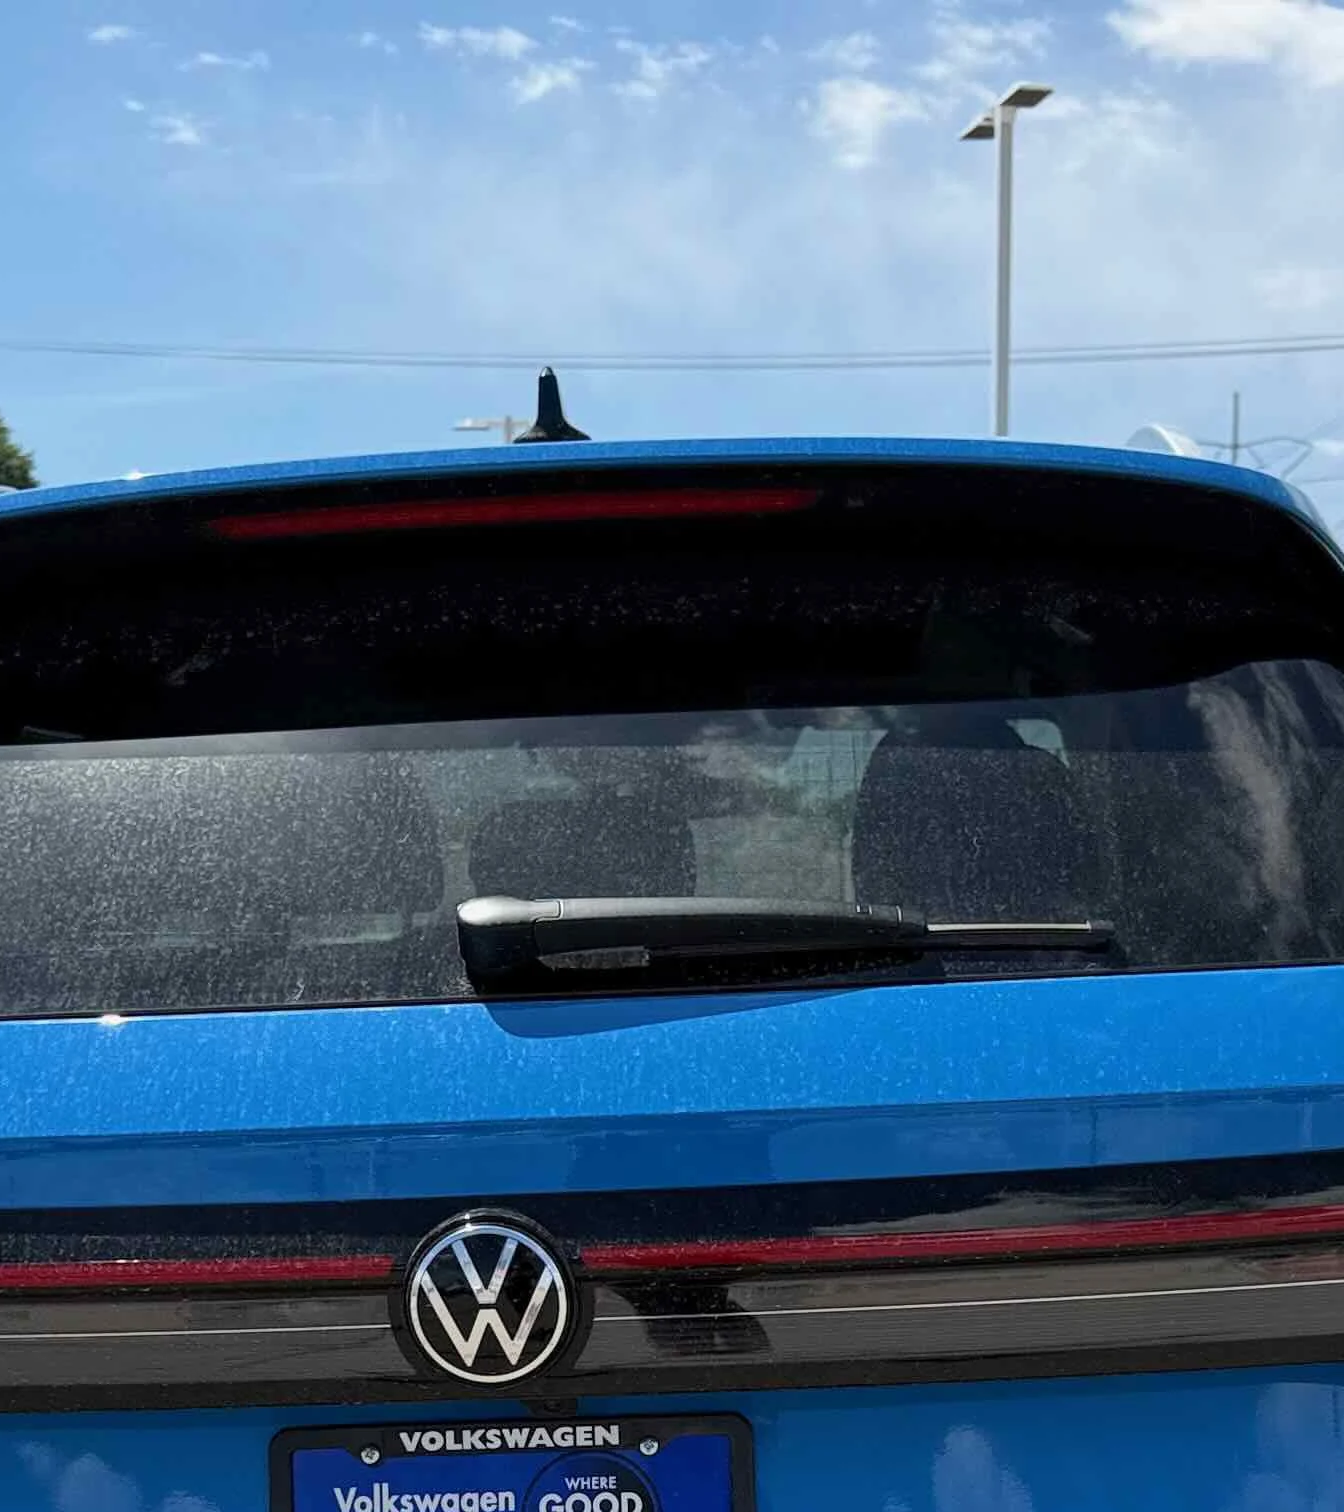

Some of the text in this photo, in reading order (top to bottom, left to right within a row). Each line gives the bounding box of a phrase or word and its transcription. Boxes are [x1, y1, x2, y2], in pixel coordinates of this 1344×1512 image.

[419, 1237, 555, 1368] VW
[398, 1424, 621, 1453] VOLKSWAGEN
[564, 1476, 617, 1490] WHERE
